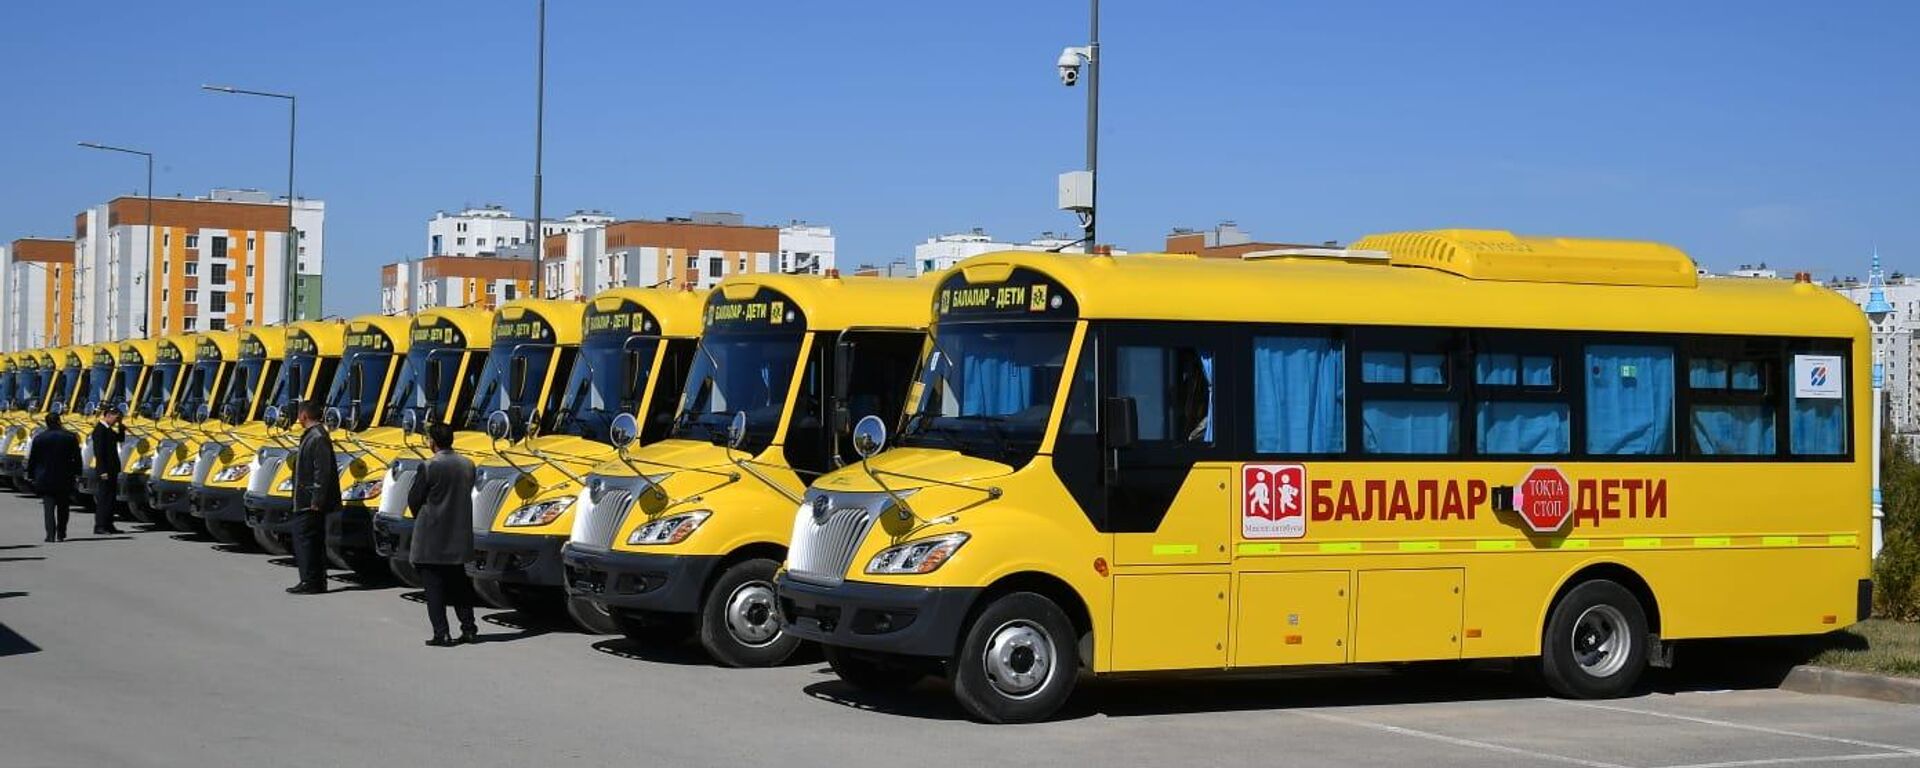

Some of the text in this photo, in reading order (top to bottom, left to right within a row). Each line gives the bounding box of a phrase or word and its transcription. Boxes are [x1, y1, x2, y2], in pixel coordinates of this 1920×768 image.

[953, 288, 989, 307] БАЛАЛАР
[996, 287, 1025, 308] ДЕТИ
[746, 303, 767, 320] ДЕТИ
[1529, 480, 1564, 498] ТОҚТА
[1311, 479, 1667, 527] БАЛАЛАР ДЕТИ
[1534, 501, 1561, 517] СТОП
